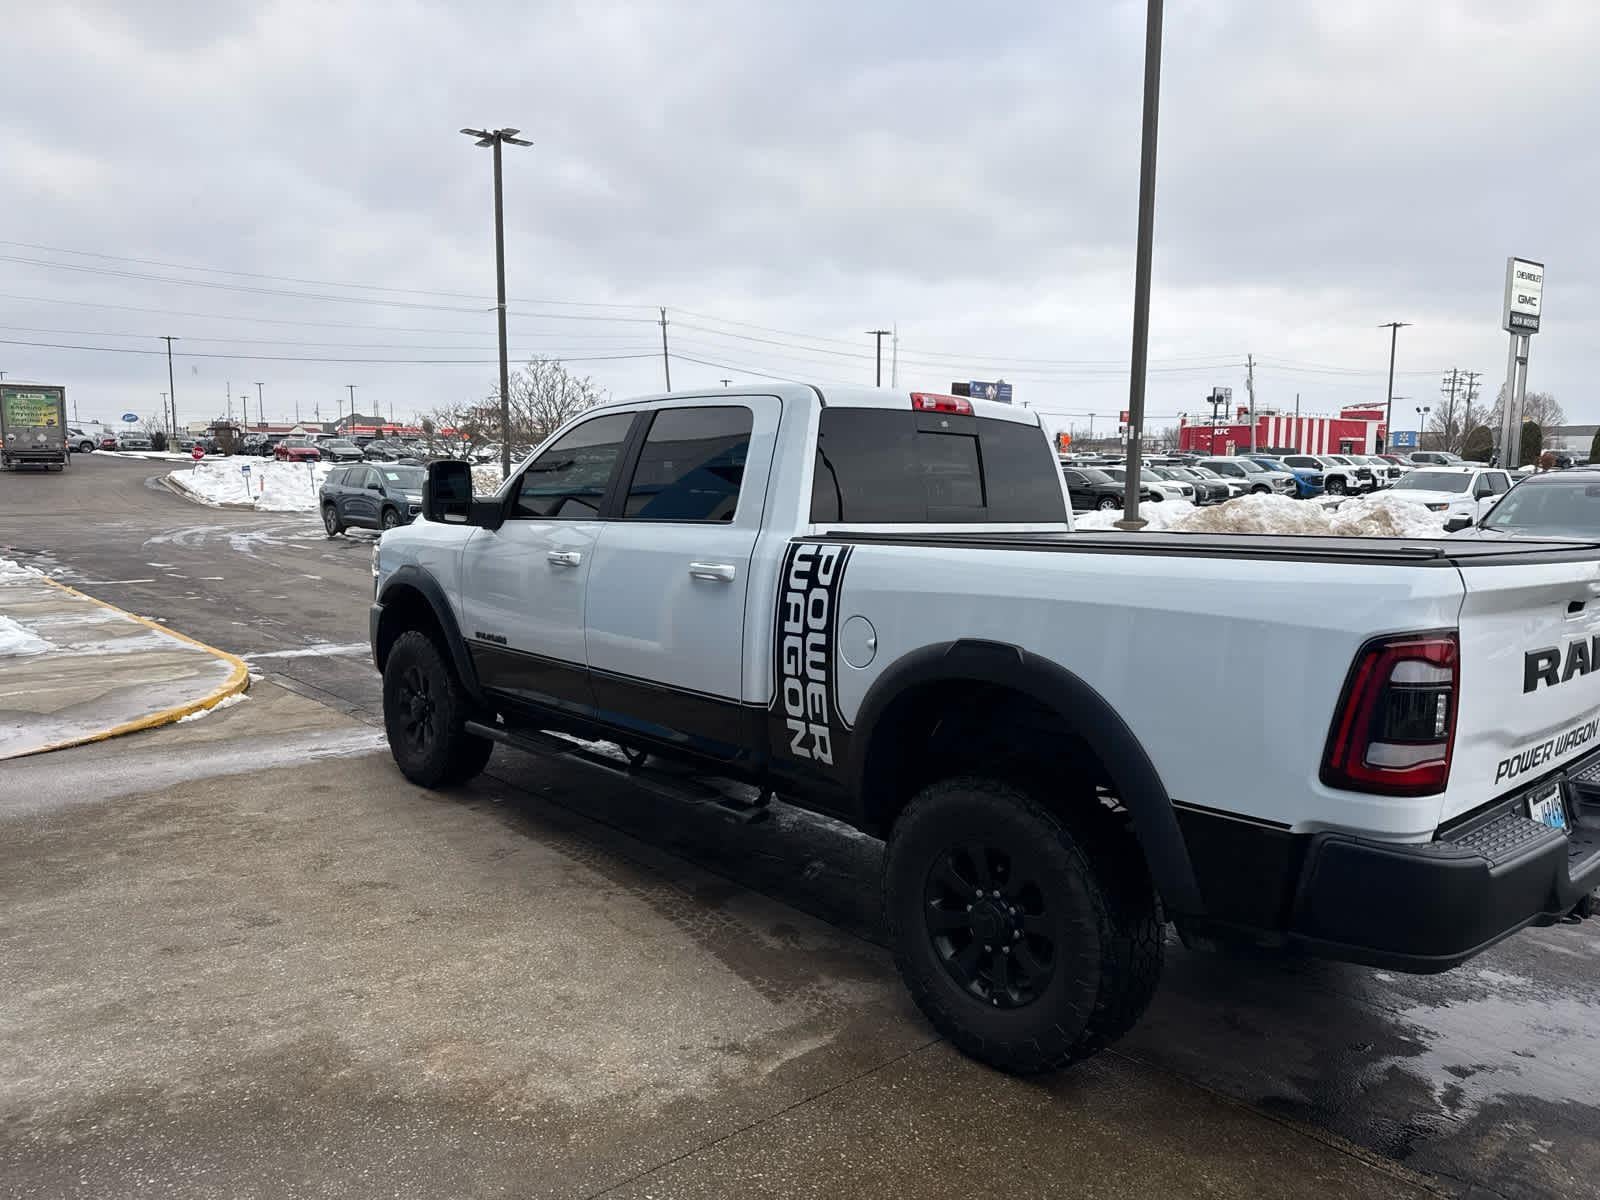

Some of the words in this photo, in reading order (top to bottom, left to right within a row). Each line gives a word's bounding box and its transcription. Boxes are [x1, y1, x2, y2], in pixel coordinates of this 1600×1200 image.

[1516, 270, 1542, 283] CHEVROLET
[1518, 294, 1537, 306] GMC
[192, 449, 204, 457] STOP
[782, 544, 818, 760] WAGON
[806, 545, 841, 765] POWER
[1495, 738, 1554, 785] POWER
[1555, 719, 1600, 757] WAGON
